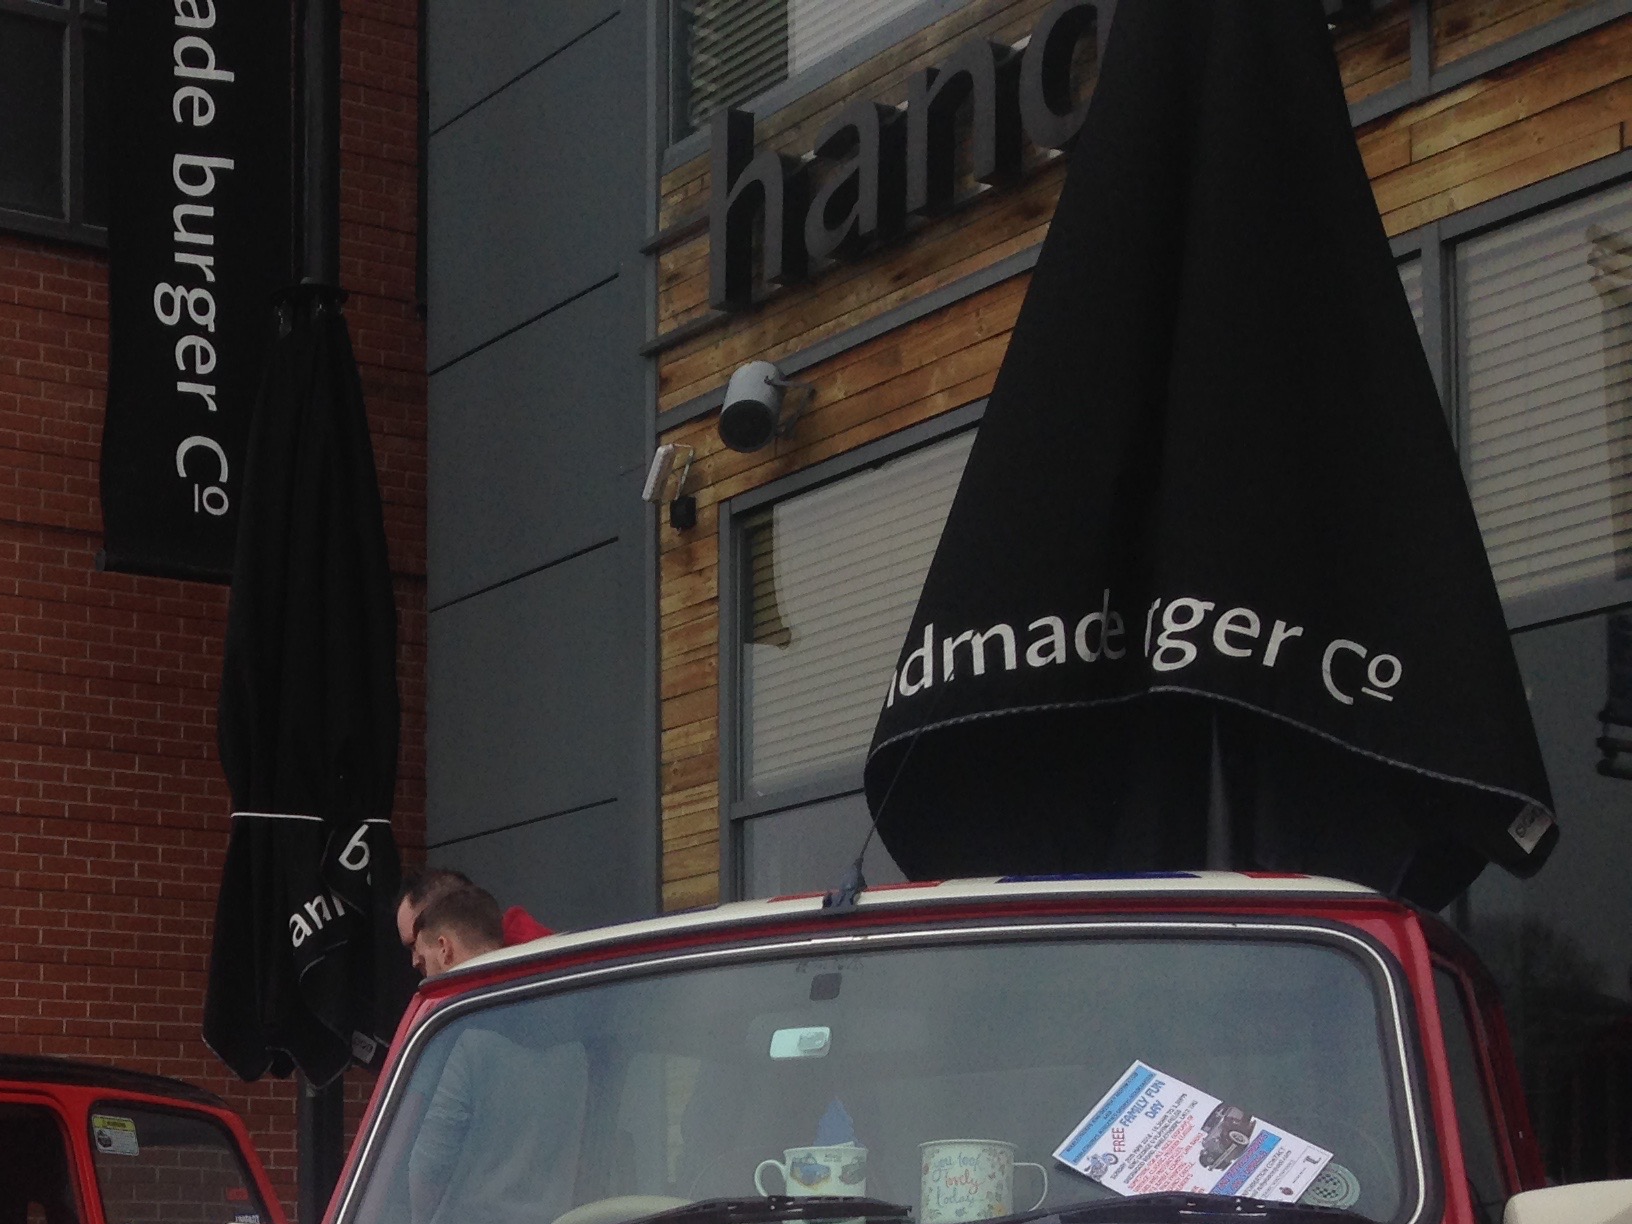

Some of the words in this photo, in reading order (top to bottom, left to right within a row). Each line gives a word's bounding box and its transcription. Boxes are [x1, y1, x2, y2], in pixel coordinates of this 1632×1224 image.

[154, 153, 235, 413] burger
[175, 435, 230, 517] Co
[1111, 1126, 1127, 1153] FREE
[1120, 1095, 1150, 1127] FAMILY
[1144, 1079, 1166, 1098] FUN
[1145, 1099, 1166, 1120] DAY
